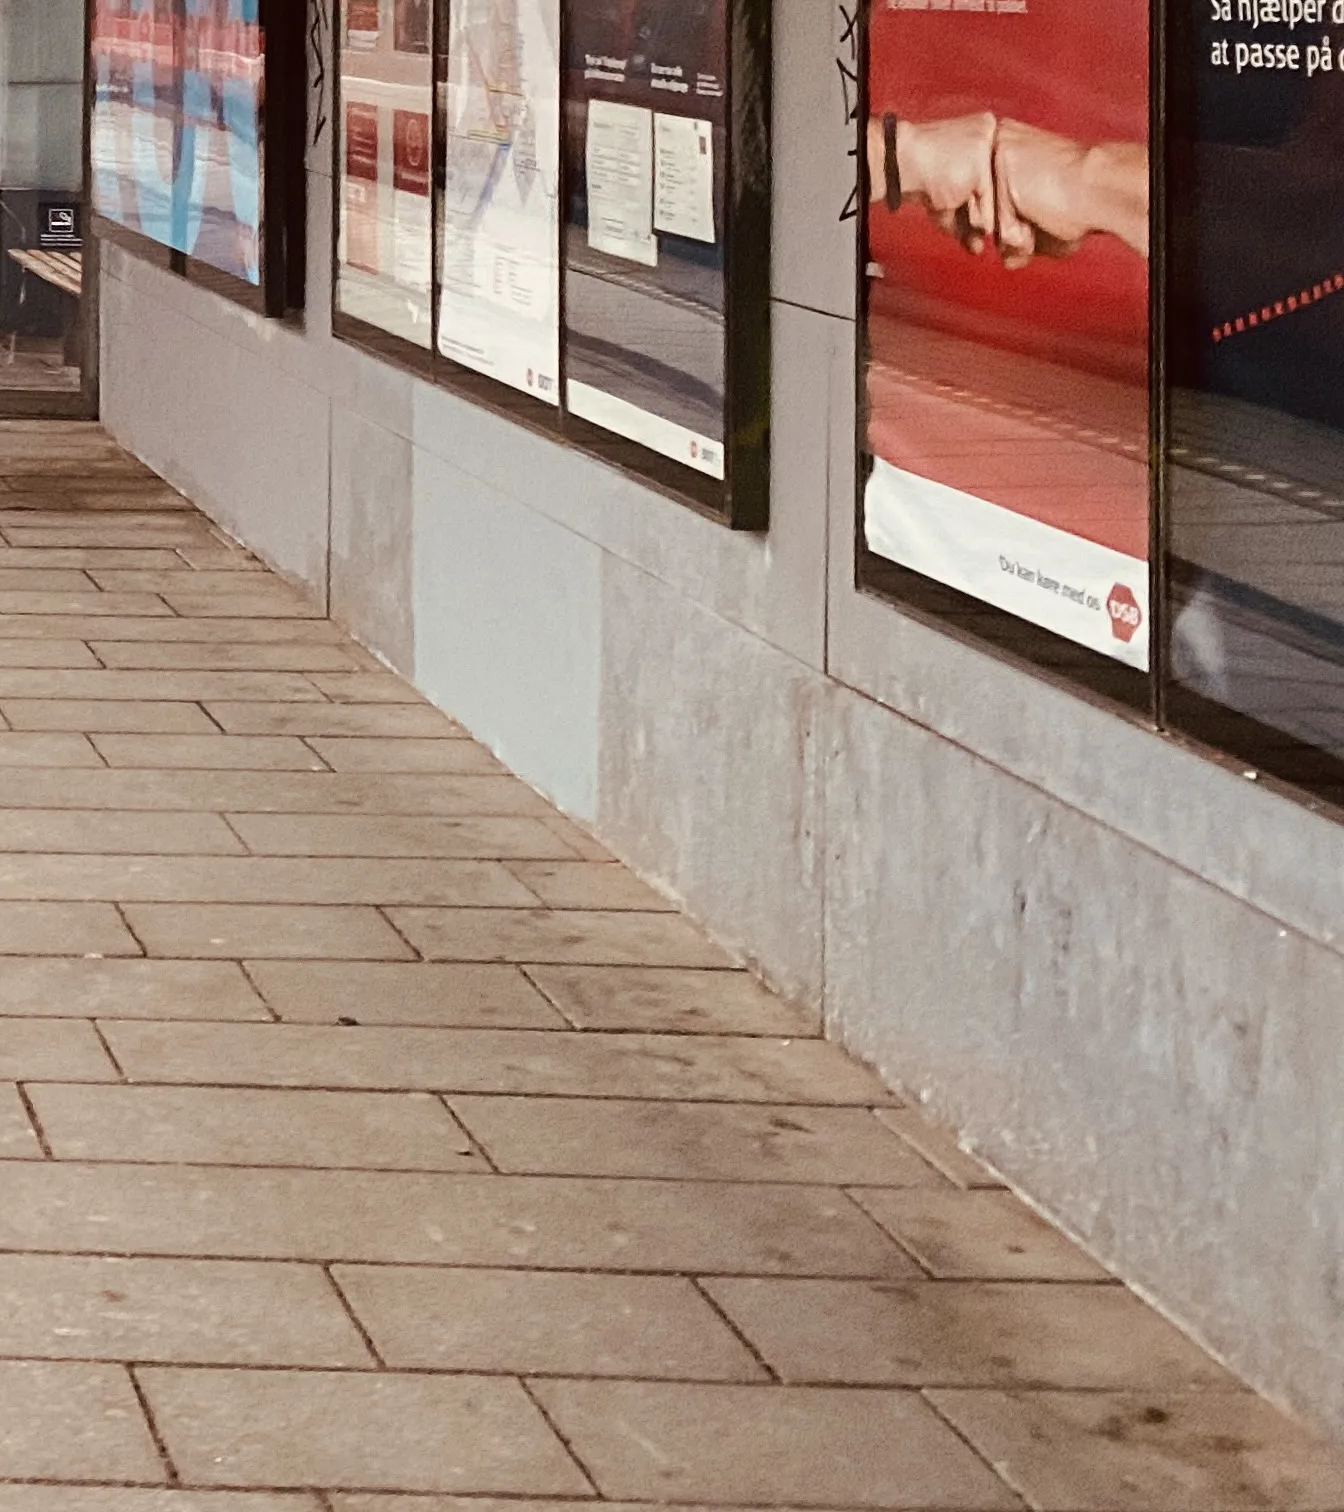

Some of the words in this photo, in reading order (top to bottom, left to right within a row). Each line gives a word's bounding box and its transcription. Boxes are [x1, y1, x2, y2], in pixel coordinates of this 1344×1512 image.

[1210, 38, 1230, 66] at
[1235, 41, 1300, 75] passe
[1306, 35, 1333, 77] på
